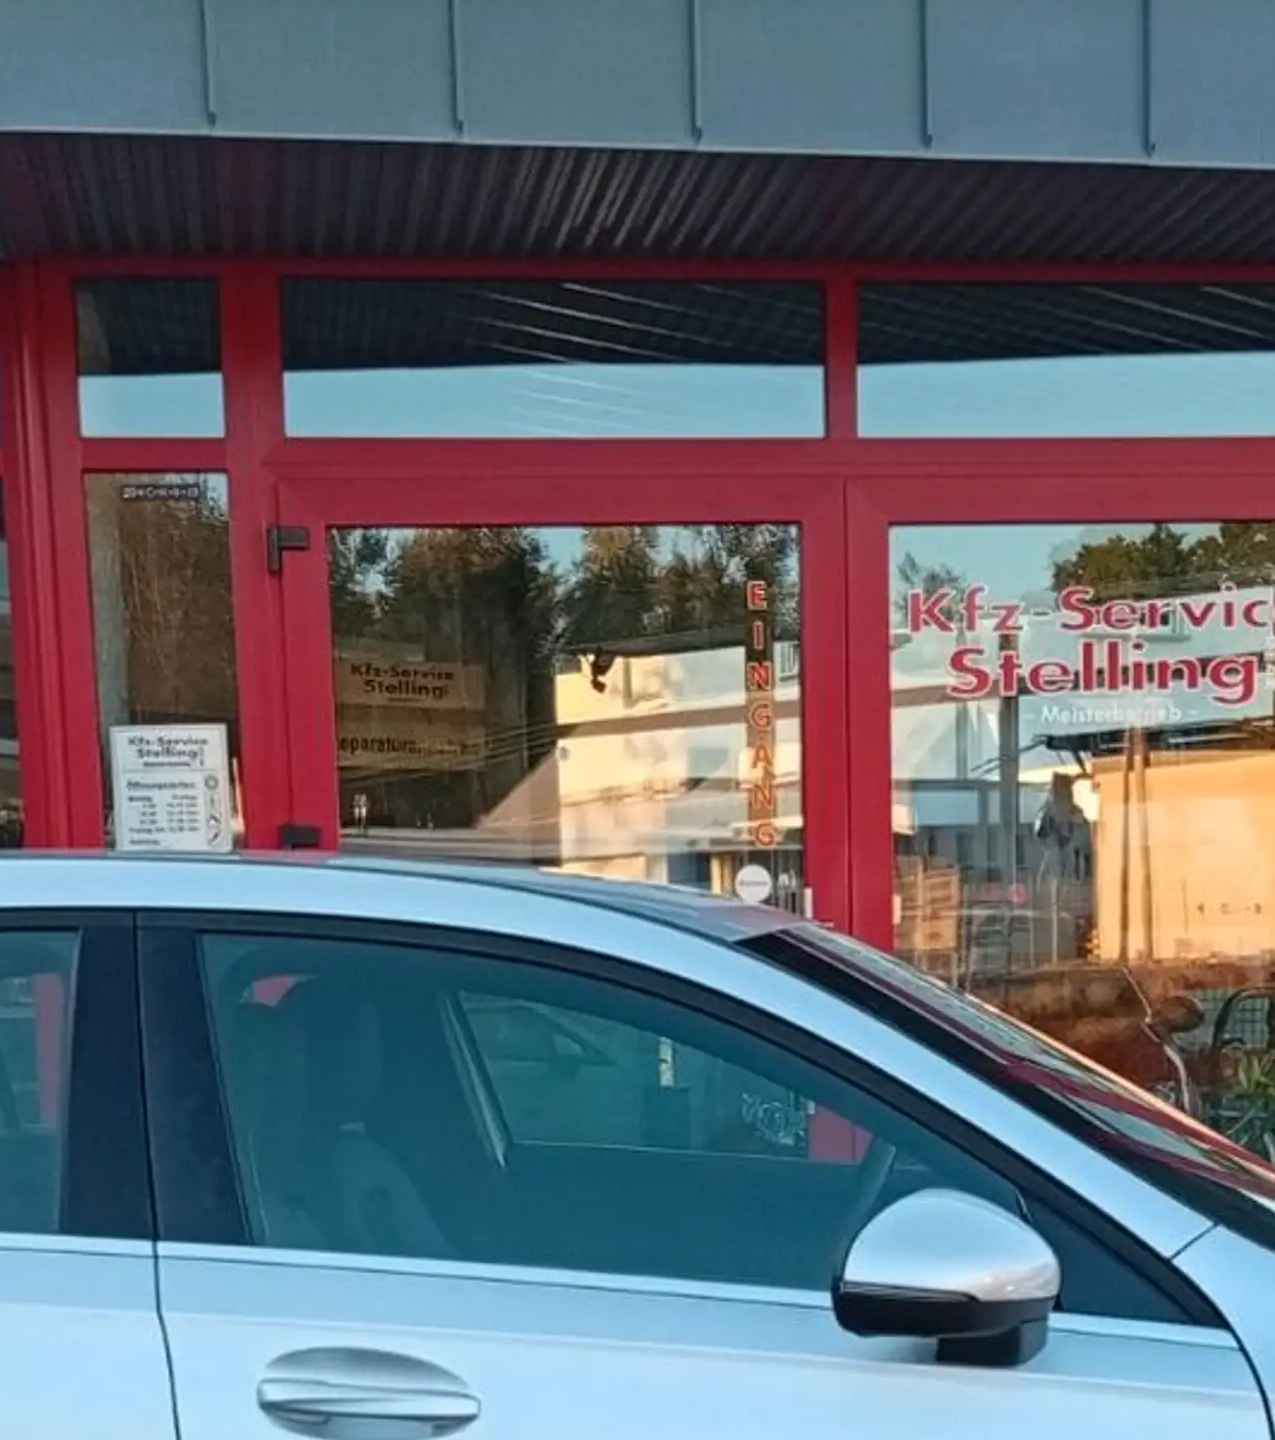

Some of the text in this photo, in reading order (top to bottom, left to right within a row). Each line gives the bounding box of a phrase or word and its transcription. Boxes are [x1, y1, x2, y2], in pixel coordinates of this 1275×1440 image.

[350, 662, 455, 681] Kfz-Service
[363, 679, 444, 700] Stelling
[947, 638, 1262, 709] Stelling
[746, 580, 776, 847] EINGANG
